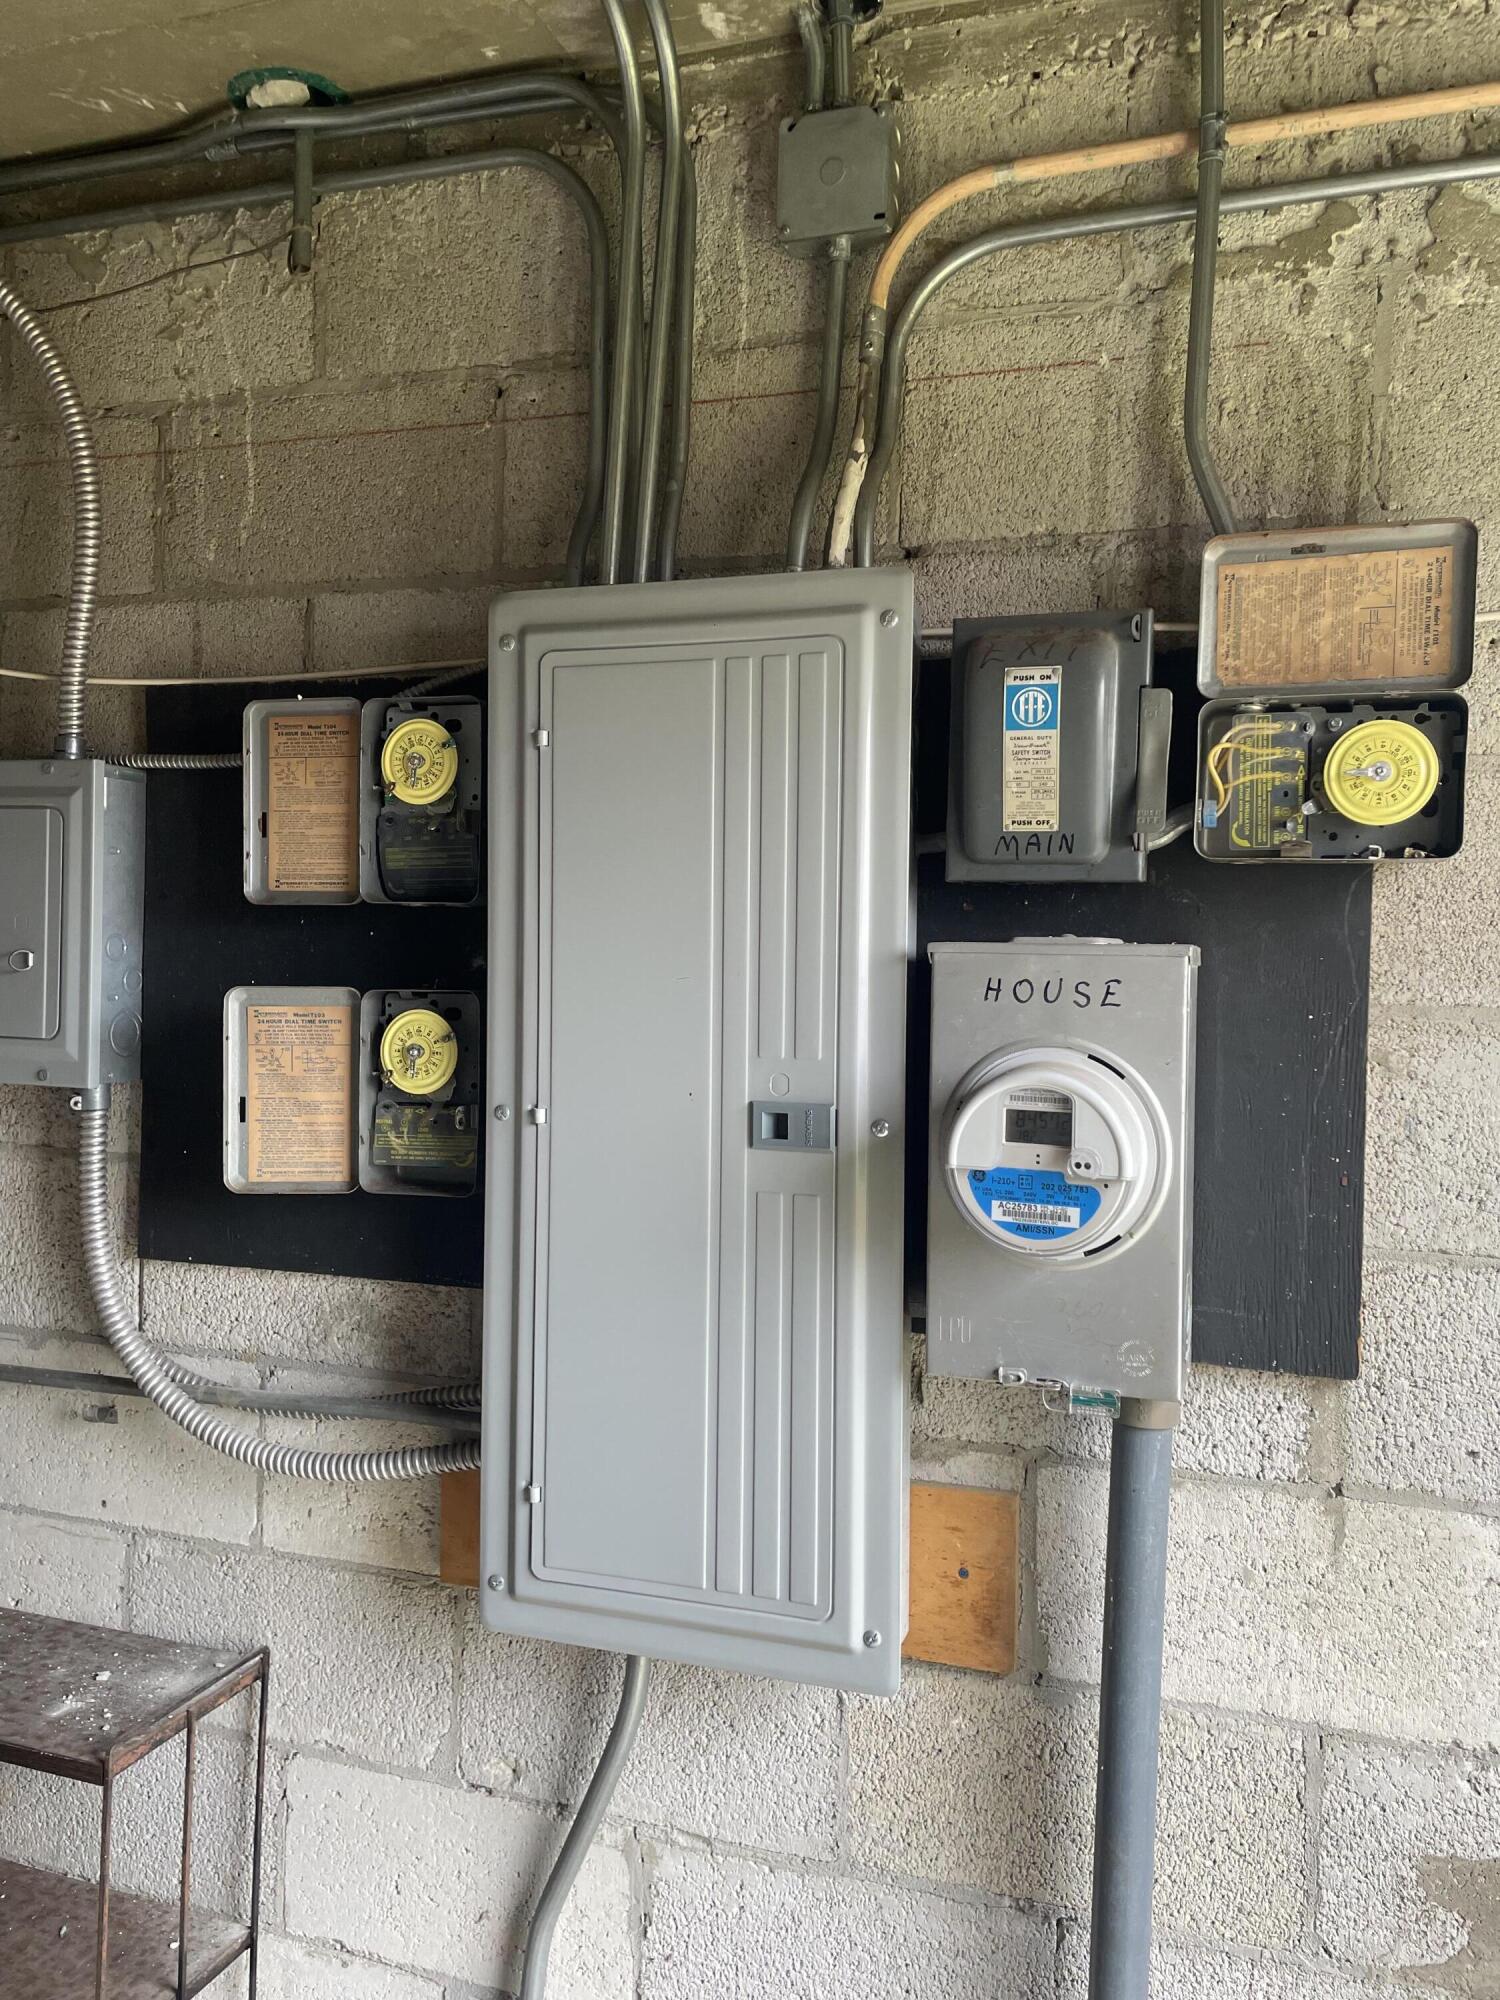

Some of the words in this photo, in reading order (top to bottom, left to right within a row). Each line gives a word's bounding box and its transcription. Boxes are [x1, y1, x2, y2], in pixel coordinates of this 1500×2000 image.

[995, 833, 1074, 860] MAIN
[984, 977, 1122, 1008] HOUSE
[805, 1109, 813, 1146] SIEMENS
[1075, 1186, 1089, 1194] 783
[998, 1202, 1037, 1212] AC25783
[1016, 1225, 1054, 1235] AMI/SSN
